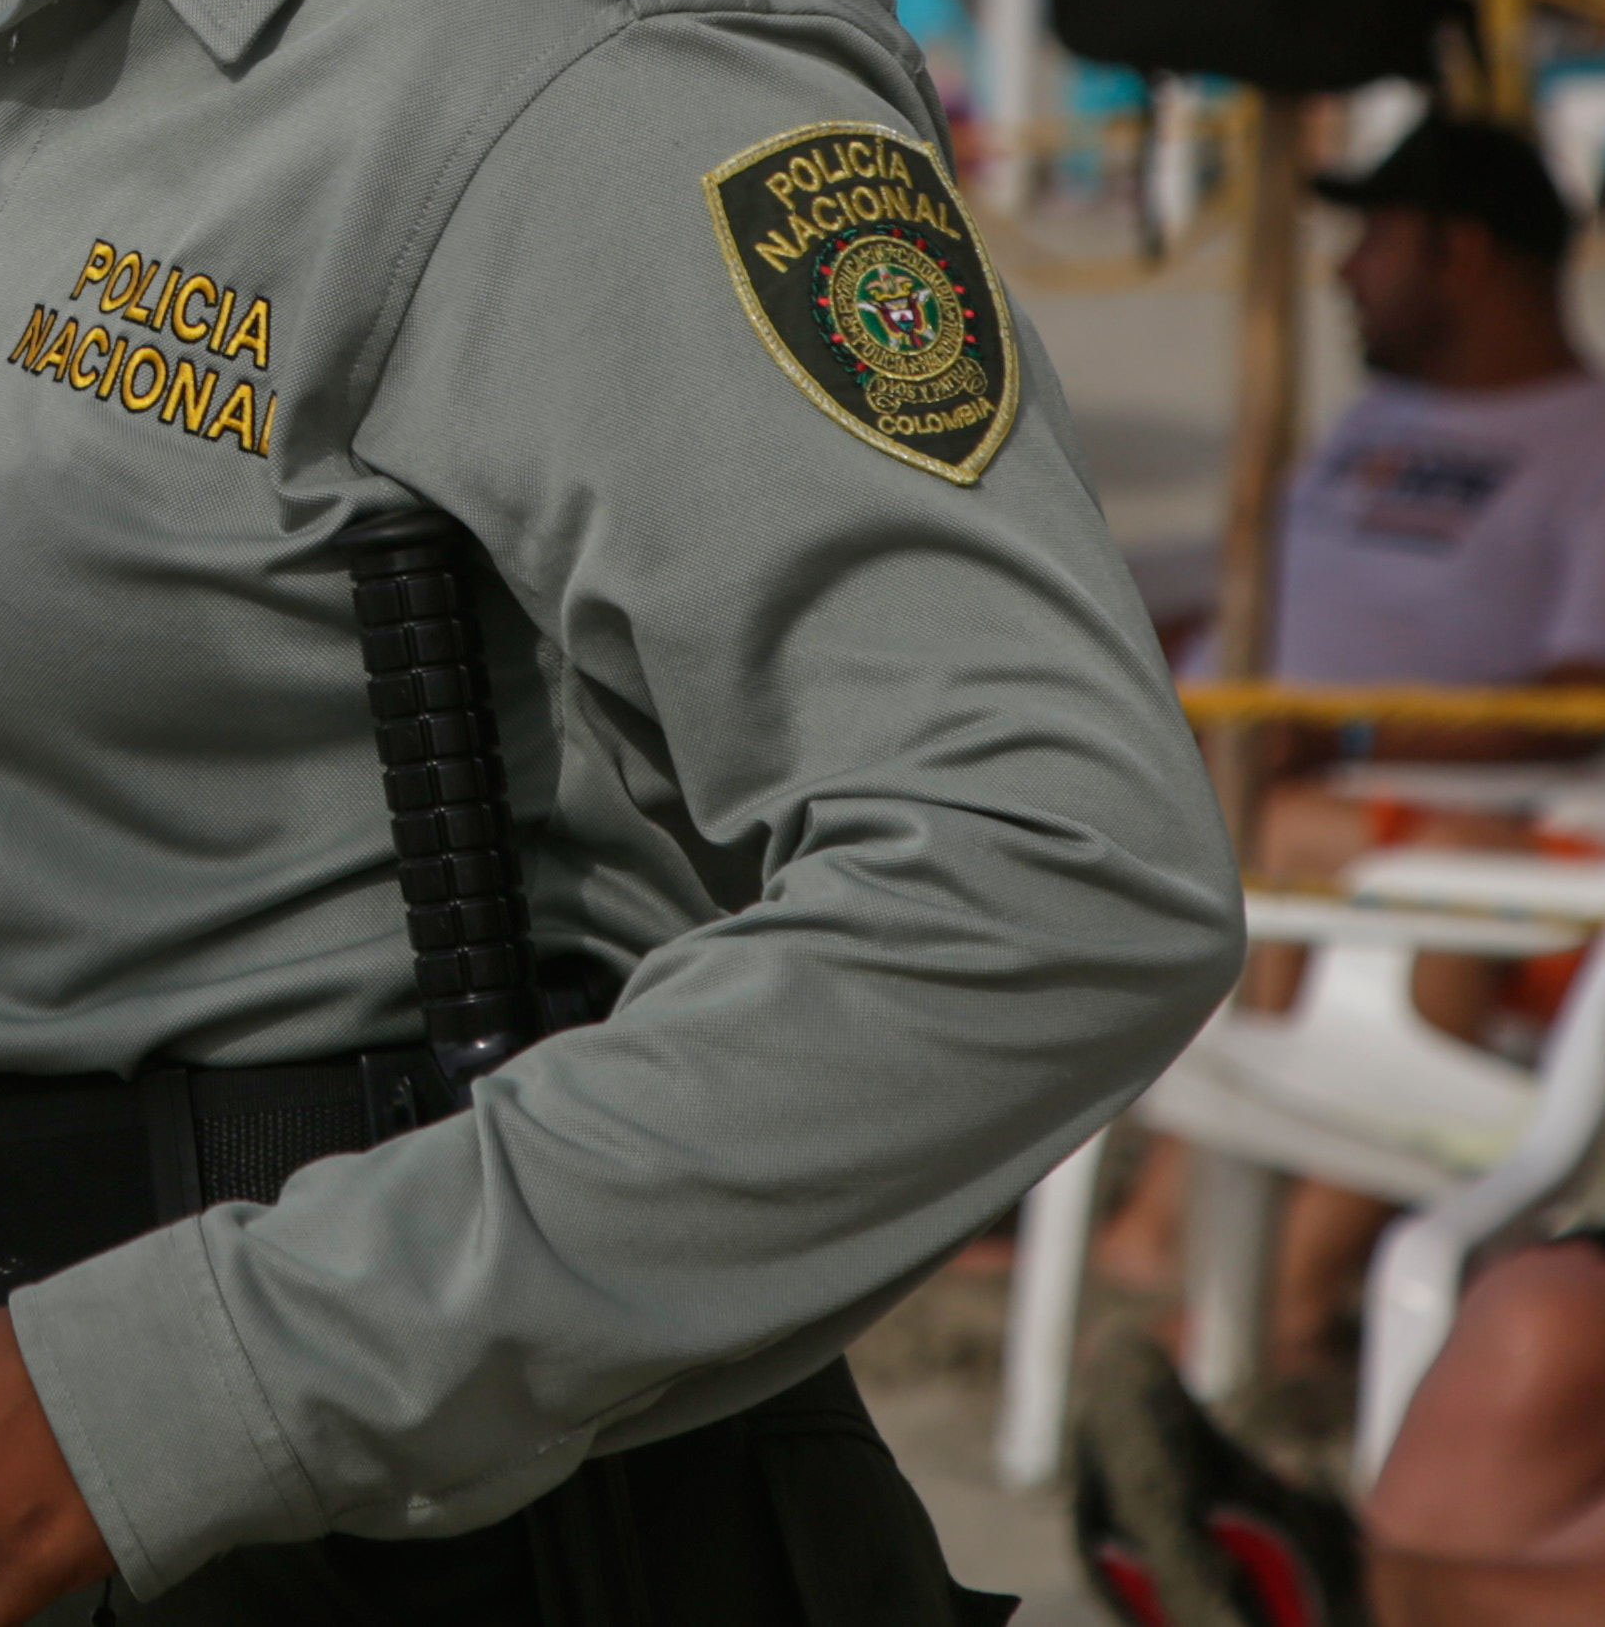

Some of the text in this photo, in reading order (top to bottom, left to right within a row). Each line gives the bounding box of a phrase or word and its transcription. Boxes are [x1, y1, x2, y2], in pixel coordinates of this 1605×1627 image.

[754, 185, 962, 273] NACIONAL
[69, 237, 271, 370] POLICIA
[876, 395, 997, 436] COLOMBIA
